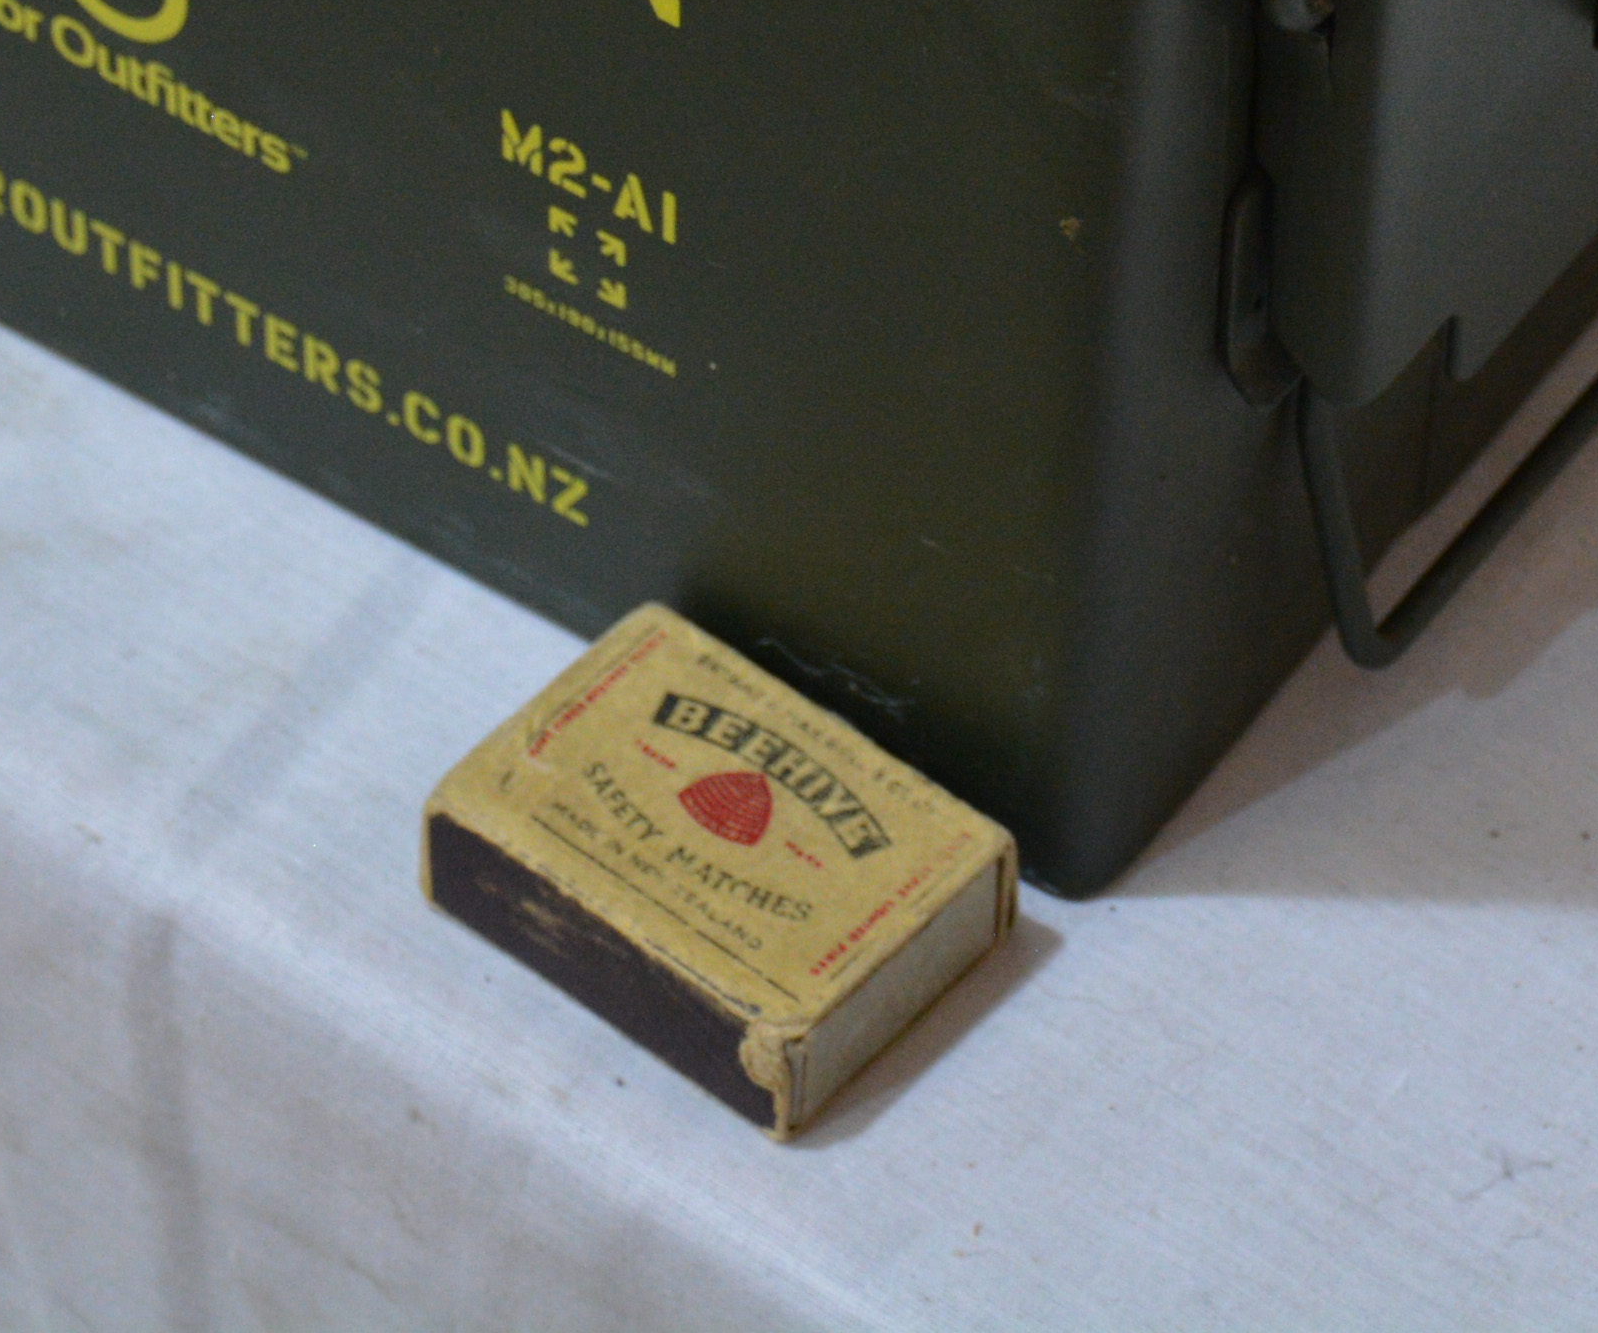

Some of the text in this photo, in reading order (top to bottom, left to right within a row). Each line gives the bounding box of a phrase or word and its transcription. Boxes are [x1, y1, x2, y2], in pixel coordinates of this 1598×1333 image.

[50, 14, 295, 176] Outfitters
[583, 761, 814, 923] SAFETY MATCHES
[656, 694, 888, 855] BEEHIVE
